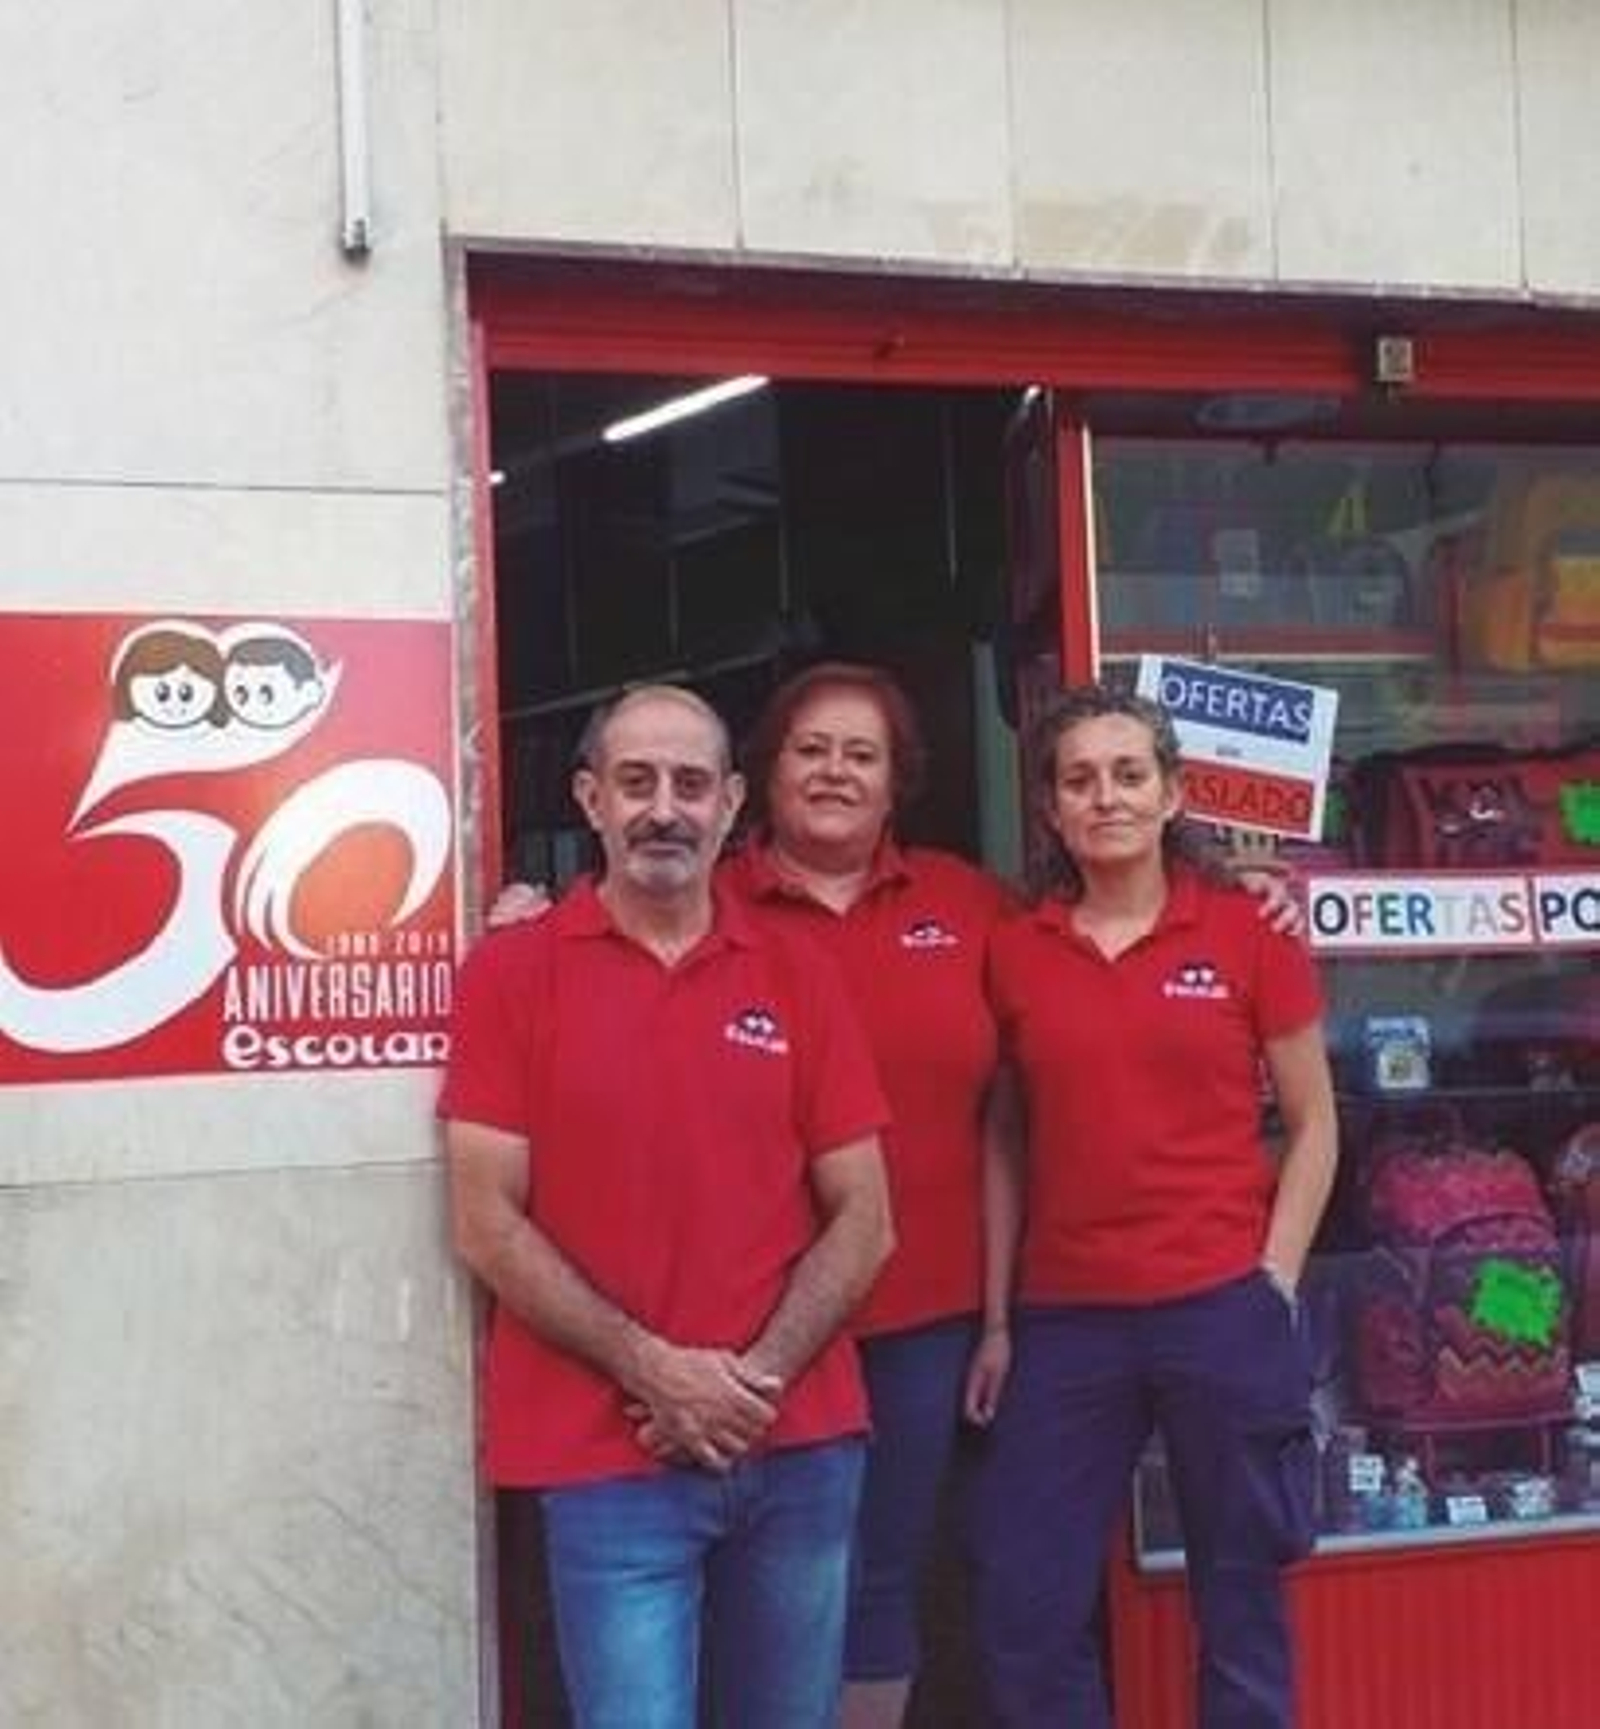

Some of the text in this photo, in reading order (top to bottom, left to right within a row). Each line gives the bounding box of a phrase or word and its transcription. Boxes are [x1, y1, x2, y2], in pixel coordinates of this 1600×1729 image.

[1161, 674, 1311, 735] OFERTAS
[1181, 768, 1312, 823] ASLADO
[1312, 890, 1526, 936] OFERTAS
[224, 961, 452, 1021] ANIVERSARIO
